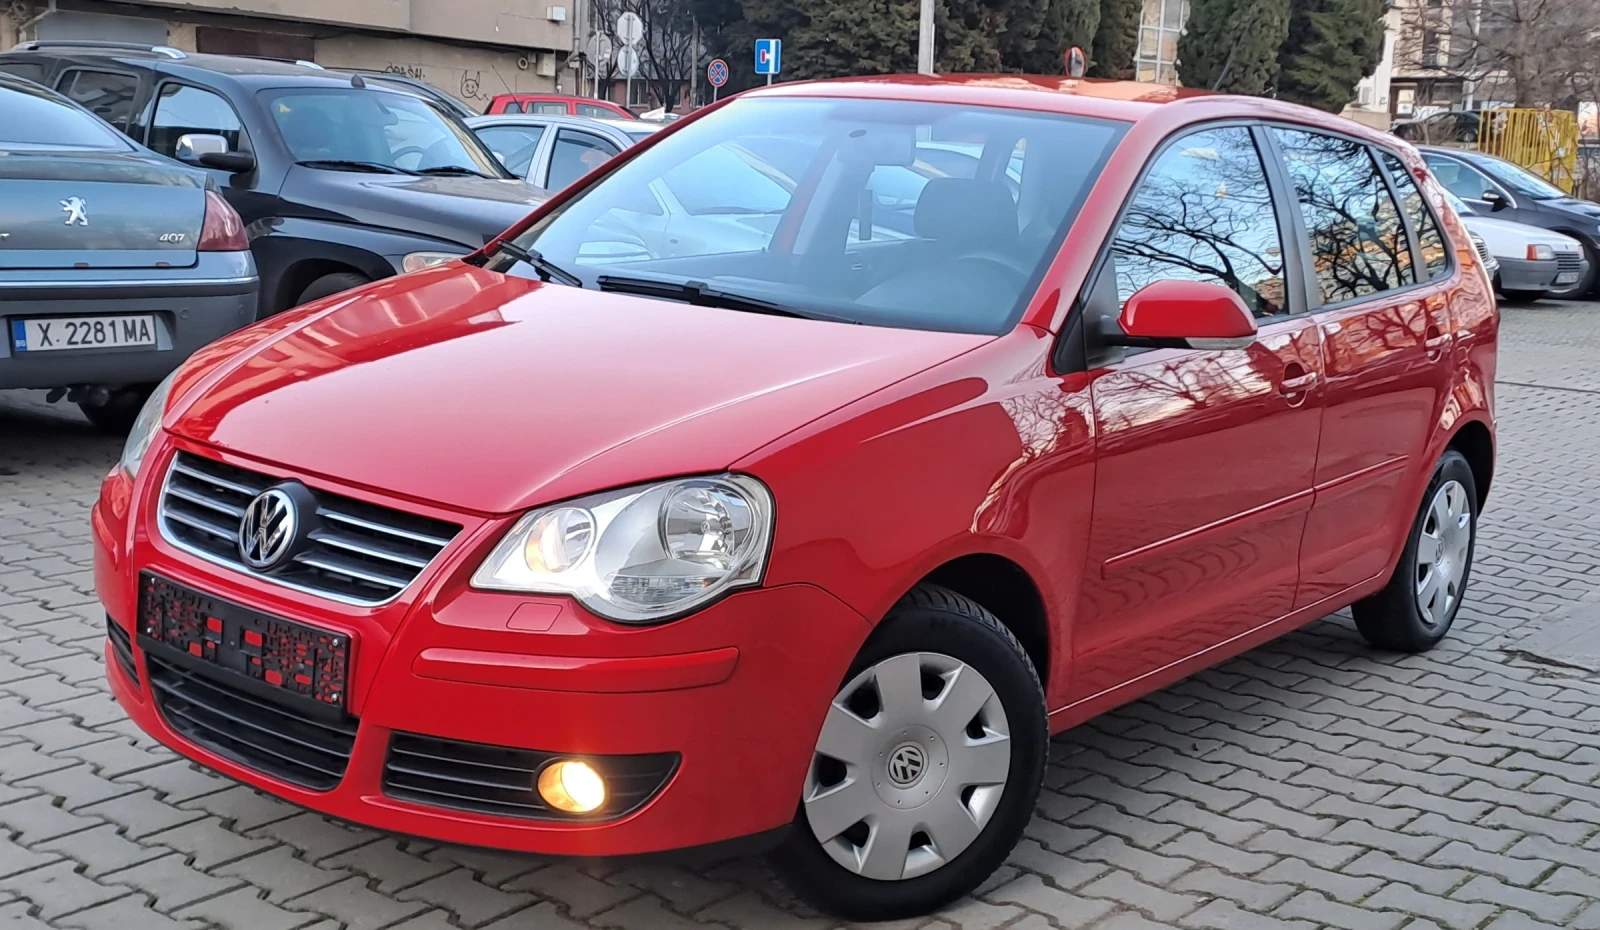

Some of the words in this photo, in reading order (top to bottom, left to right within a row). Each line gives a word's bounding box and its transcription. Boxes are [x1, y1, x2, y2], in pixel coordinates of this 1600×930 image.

[159, 233, 185, 243] 407
[65, 319, 118, 346] 2281
[123, 318, 151, 343] MA
